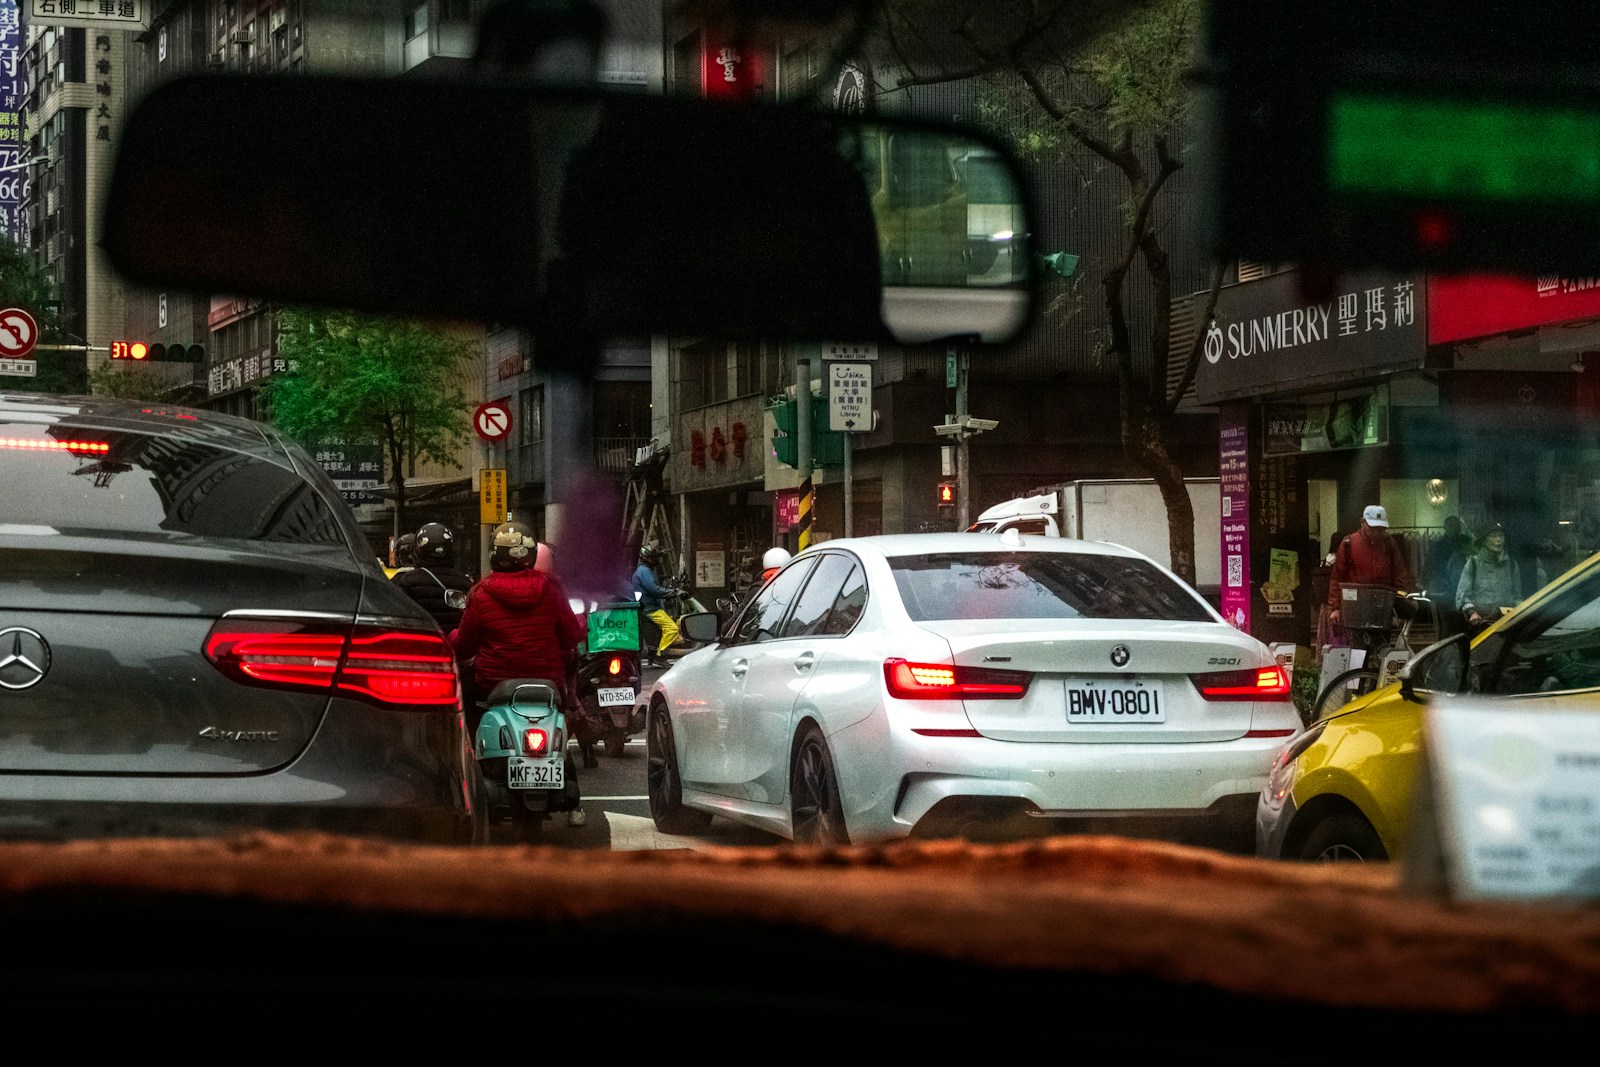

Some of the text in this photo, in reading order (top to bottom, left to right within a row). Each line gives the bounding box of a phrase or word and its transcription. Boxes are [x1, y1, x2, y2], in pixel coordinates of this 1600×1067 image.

[40, 0, 135, 18] 右側二車道
[1227, 281, 1415, 360] SUNMERRY 聖瑪莉
[112, 342, 128, 359] 37
[598, 617, 628, 629] Uber
